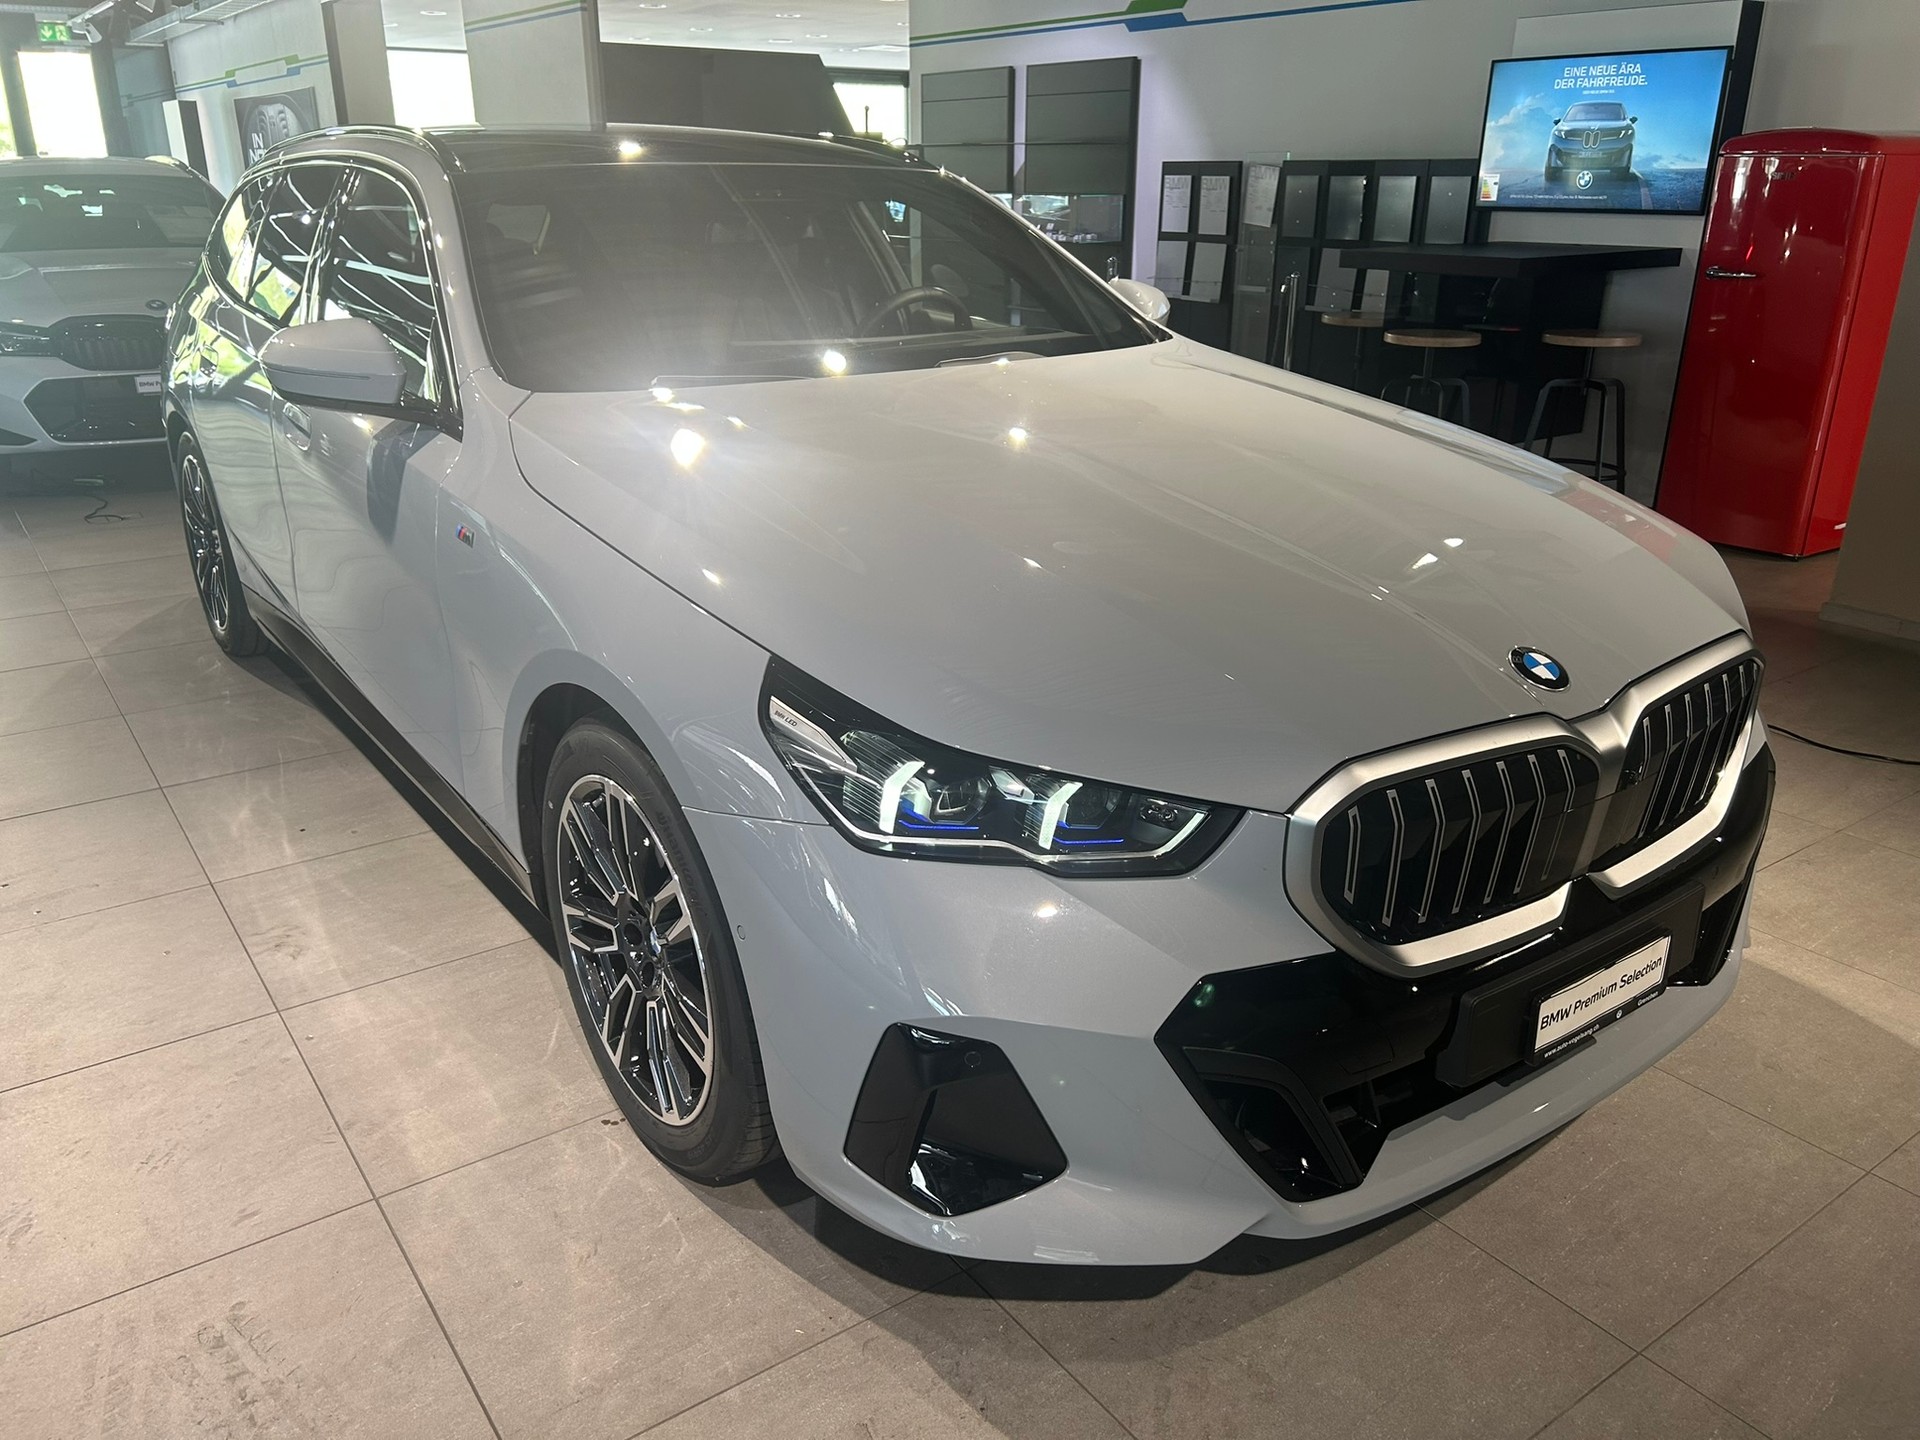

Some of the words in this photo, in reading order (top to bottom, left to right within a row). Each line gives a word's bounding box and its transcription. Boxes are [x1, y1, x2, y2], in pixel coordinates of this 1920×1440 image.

[1563, 66, 1588, 77] EINE
[1589, 64, 1617, 76] NEUE
[1618, 62, 1642, 74] ÄRA
[1553, 78, 1574, 89] DER
[1576, 75, 1648, 88] FAHRFREUDE.
[251, 132, 264, 149] IN
[784, 716, 798, 727] LED
[1540, 1005, 1572, 1030] BMW
[1573, 981, 1618, 1015] Premium
[1618, 956, 1663, 989] Selection
